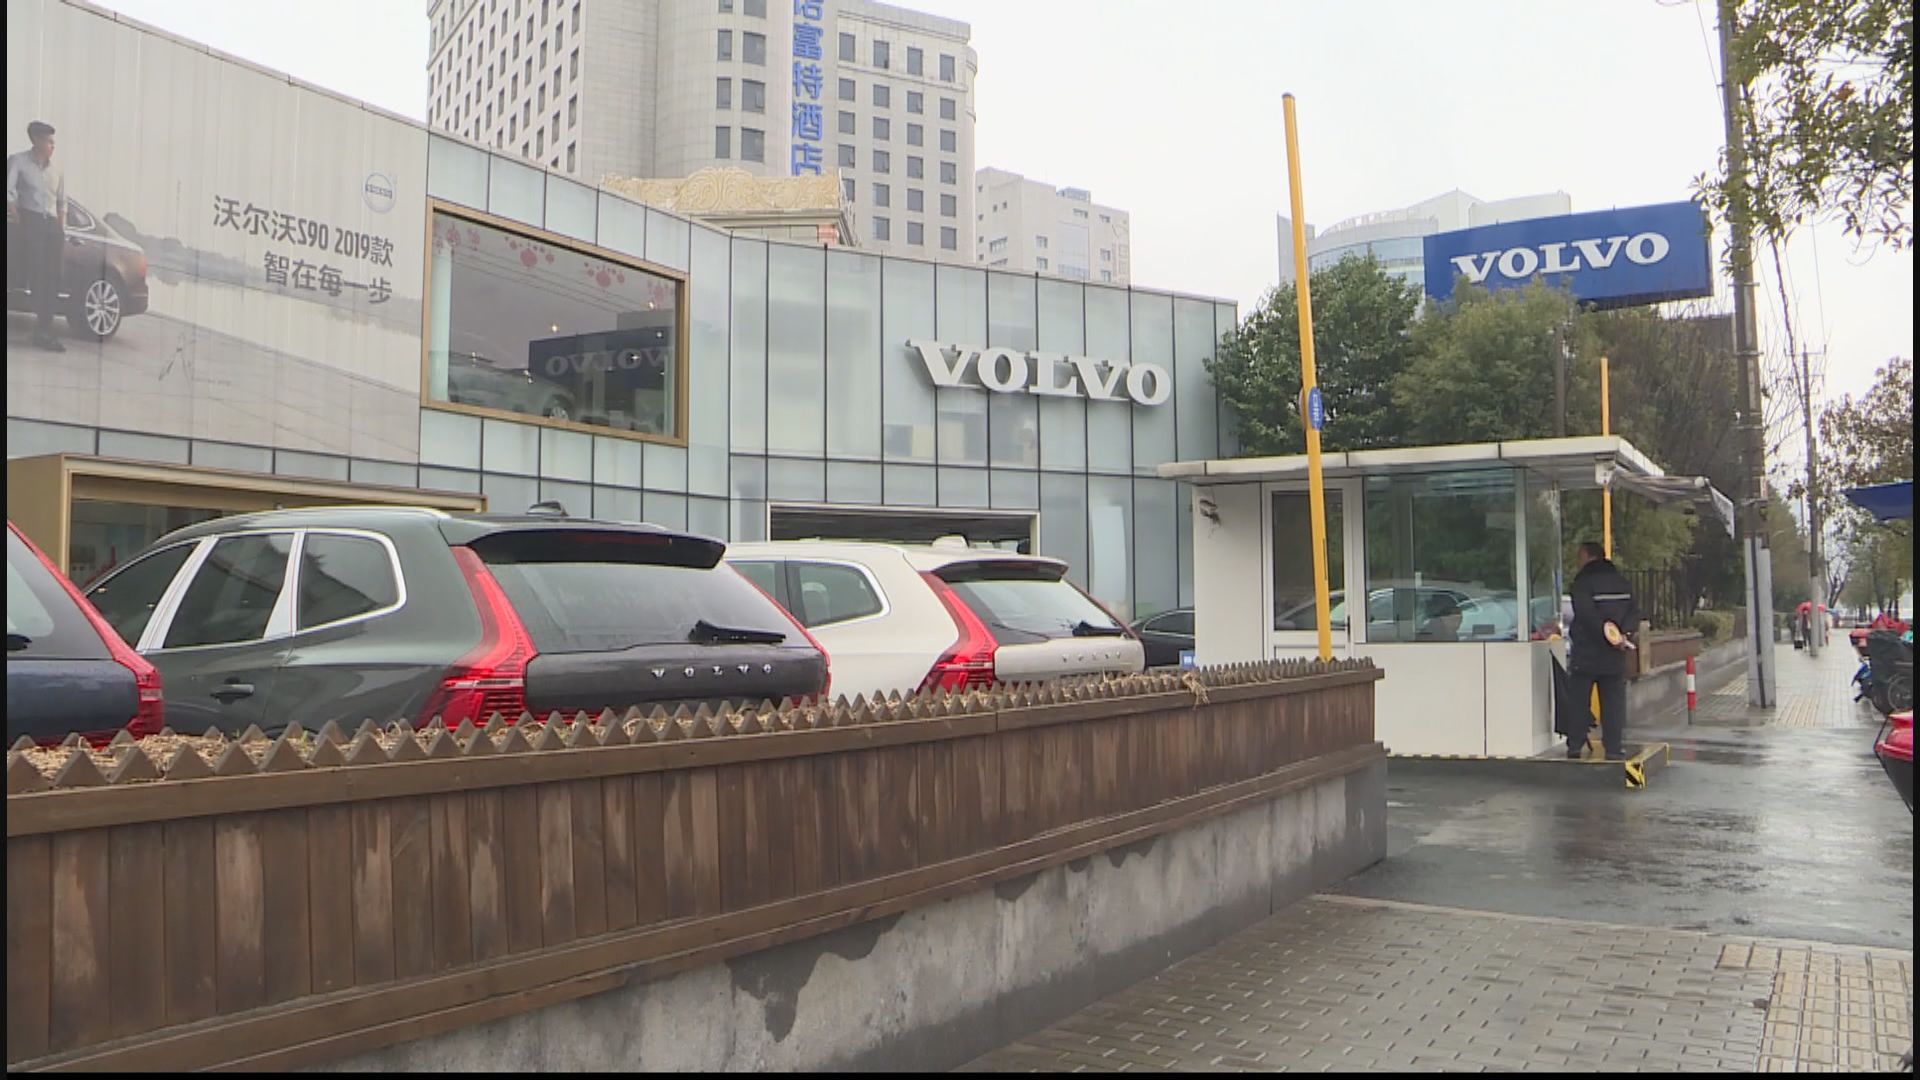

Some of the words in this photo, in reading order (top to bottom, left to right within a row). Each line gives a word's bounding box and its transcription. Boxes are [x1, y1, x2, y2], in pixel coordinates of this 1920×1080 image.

[213, 194, 329, 250] 沃尔沃S90
[334, 228, 394, 268] 2019款
[1450, 232, 1670, 284] VOLVO
[264, 250, 393, 304] 智在每一步
[906, 338, 1172, 405] VOLVO
[651, 663, 772, 679] VOLVO
